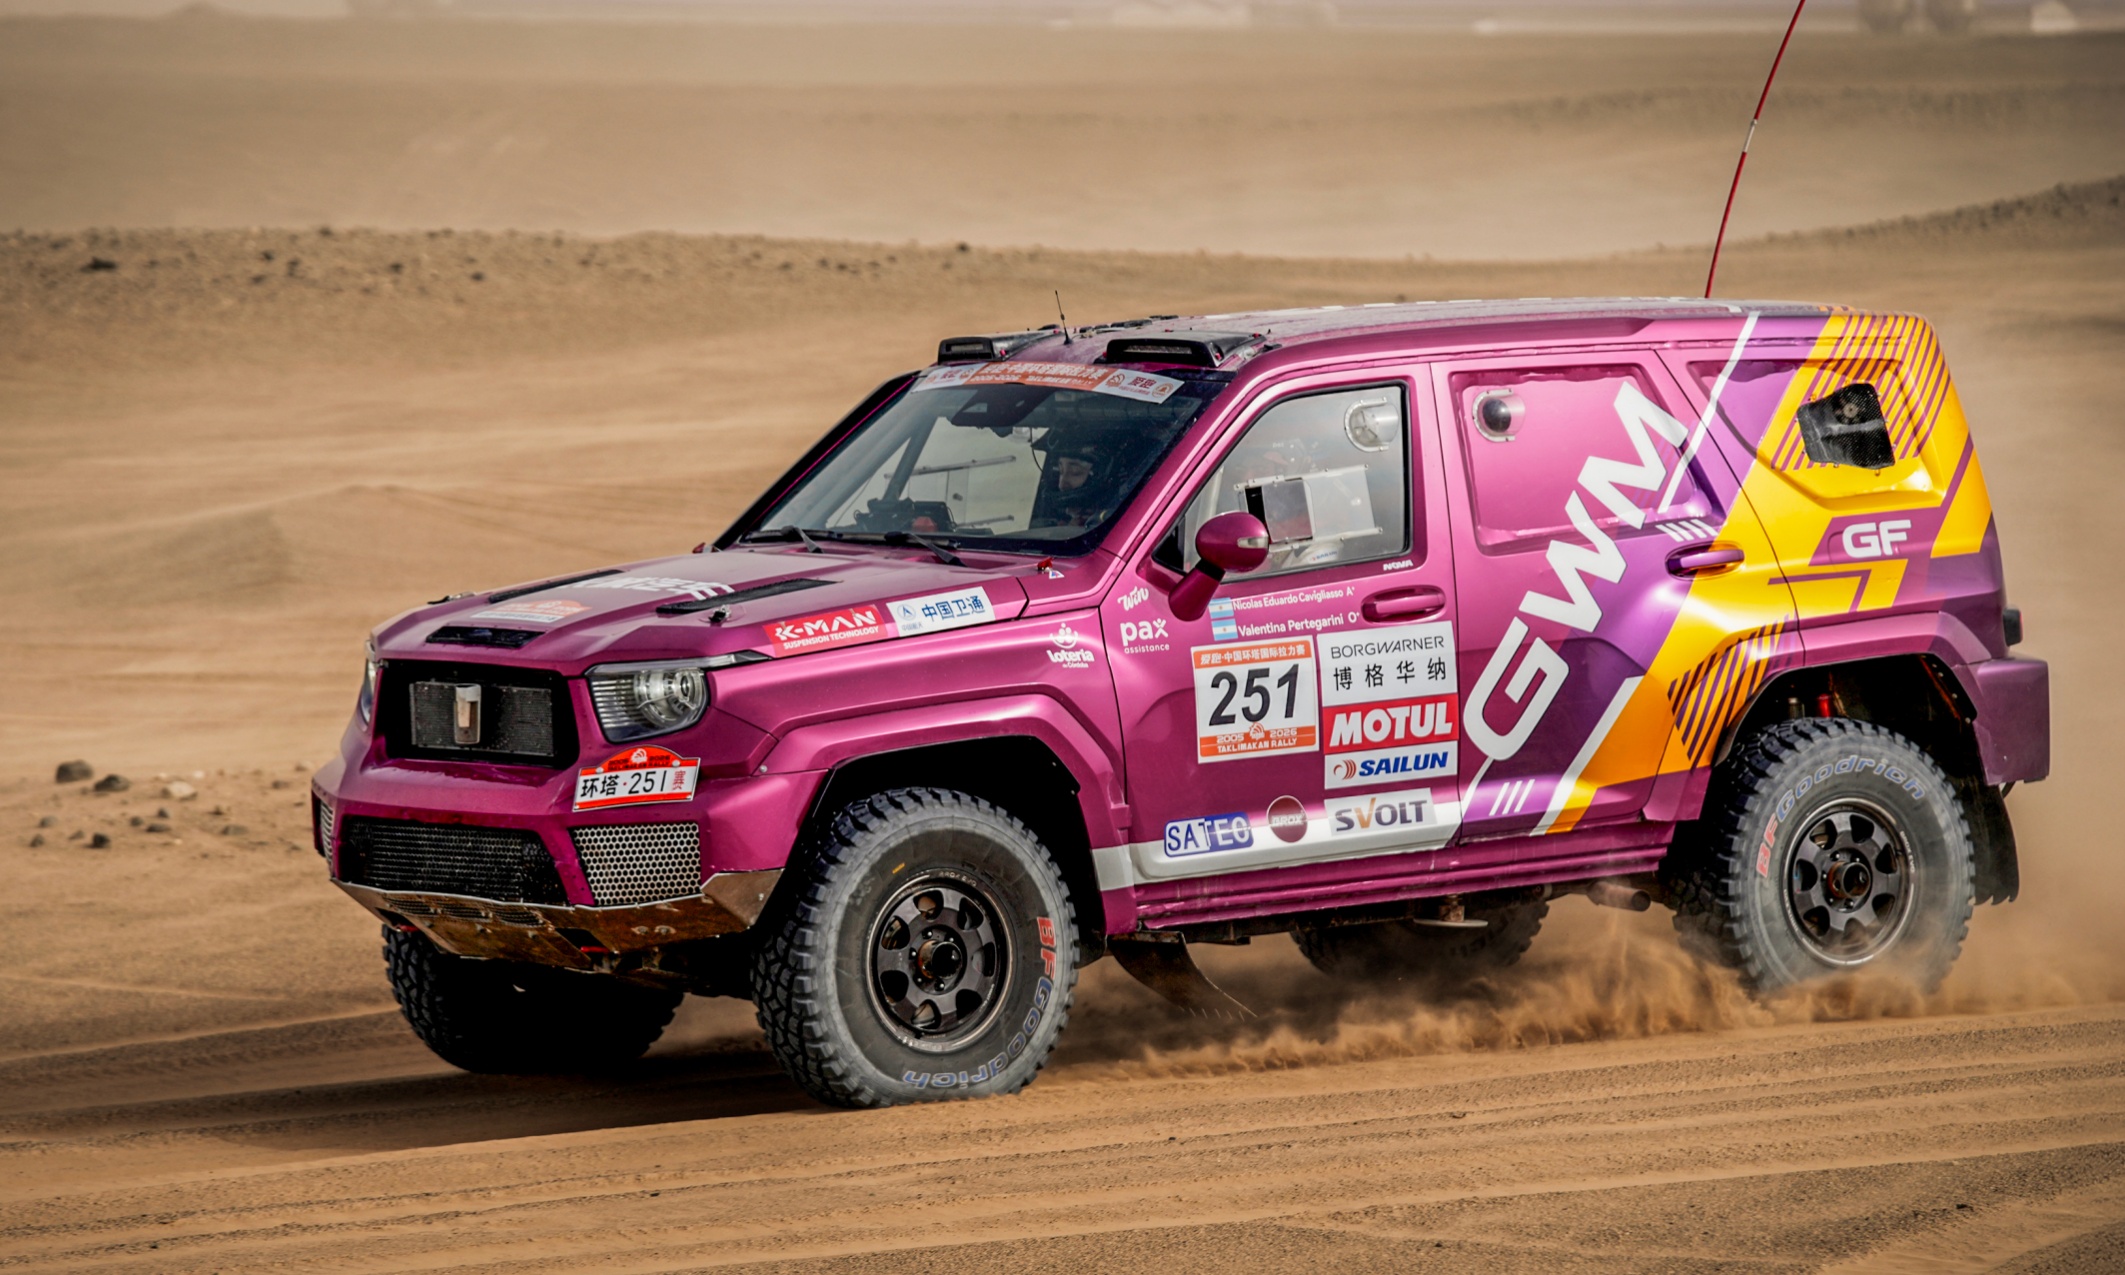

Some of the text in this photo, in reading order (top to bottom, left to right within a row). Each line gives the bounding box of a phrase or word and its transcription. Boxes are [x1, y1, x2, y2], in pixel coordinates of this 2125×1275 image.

[1842, 519, 1912, 558] GF
[1463, 382, 1689, 761] GWM
[921, 596, 985, 622] 中国卫通
[1232, 599, 1263, 611] Nicolas
[1263, 593, 1299, 608] Eduardo
[1298, 589, 1344, 604] Cavigliasso
[775, 611, 877, 641] K-MAN
[783, 625, 880, 650] SUSPENSION TECHNOLOGY
[1238, 622, 1287, 637] Valentina
[1287, 613, 1344, 632] Pertegarini
[1124, 643, 1170, 655] assistance
[1331, 636, 1445, 659] BORGWARNER
[1333, 657, 1447, 691] 博格华纳
[1208, 663, 1300, 727] 251
[1217, 727, 1298, 745] 2005 2026
[1329, 702, 1453, 748] MOTUL
[1217, 737, 1298, 753] TAKLIMAKAN RALLY
[1359, 751, 1449, 778] SAILUN
[1335, 797, 1428, 832] SVOLT
[1756, 754, 1927, 878] BFGoodrich
[901, 916, 1057, 1090] BFGoodrich
